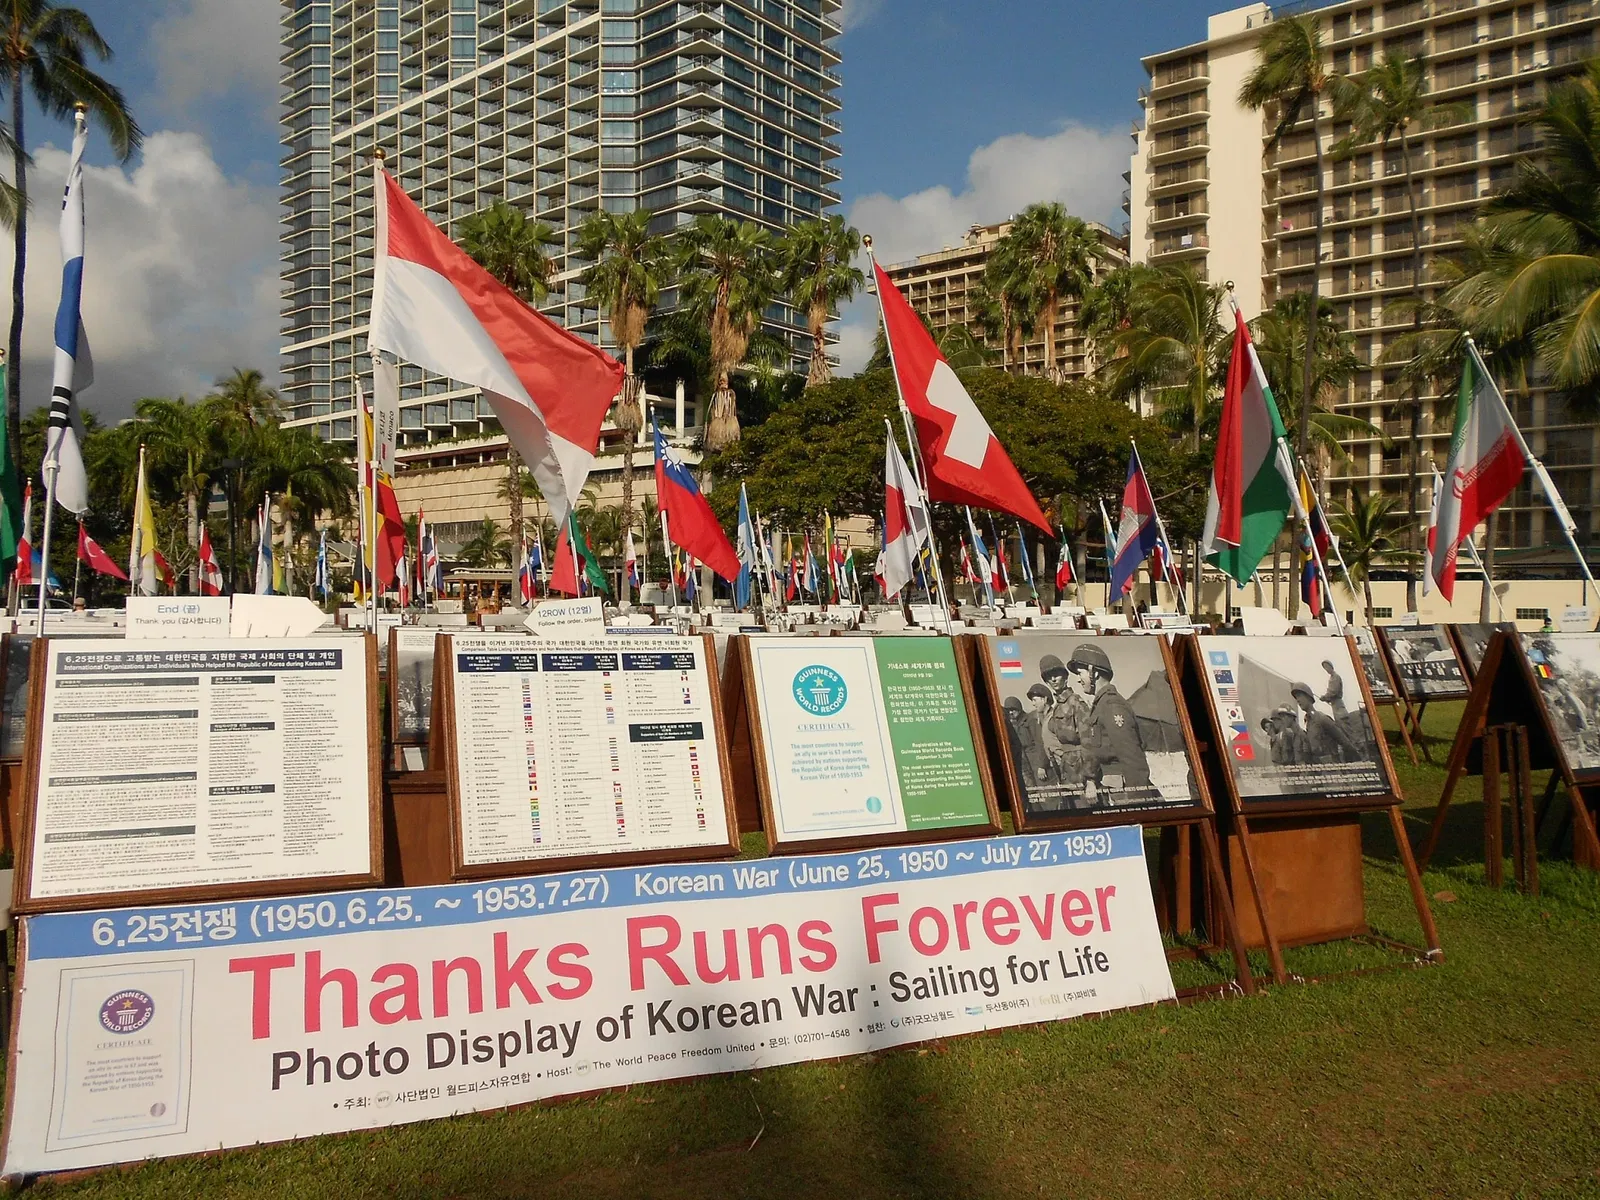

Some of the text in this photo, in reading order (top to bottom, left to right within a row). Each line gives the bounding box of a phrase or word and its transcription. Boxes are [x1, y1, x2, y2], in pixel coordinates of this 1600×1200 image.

[158, 604, 200, 614] End (끝)
[538, 605, 592, 618] 12ROW (12열)
[178, 617, 222, 626] (감사합니다)
[165, 653, 207, 662] 대한민국을
[212, 652, 236, 661] 지원한
[240, 652, 256, 660] 국제
[260, 652, 284, 660] 사회의
[288, 652, 304, 660] 단체
[308, 652, 316, 660] 및
[319, 652, 335, 660] 개인
[798, 668, 839, 683] GUINNESS
[796, 686, 845, 713] WORLD RECORDS
[797, 722, 852, 730] CERTIFICATE
[92, 906, 236, 947] 6.25전쟁
[250, 896, 422, 937] (1950.6.25.
[472, 874, 609, 913] 1953.7.27)
[634, 872, 725, 896] Korean
[734, 867, 780, 890] War
[788, 860, 849, 888] (June
[858, 857, 890, 881] 25,
[901, 849, 948, 872] 1950
[981, 844, 1022, 868] July
[1030, 840, 1058, 863] 27,
[1064, 834, 1113, 858] 1953)
[229, 885, 1116, 1040] Thanks Runs Forever
[107, 991, 149, 1007] GUINNESS
[102, 1006, 152, 1032] WORLD RECORDS
[272, 945, 1110, 1090] Photo Display of Korean War : Sailing for Life
[96, 1038, 154, 1049] CERTIFICATE
[344, 1096, 371, 1110] 주최:
[395, 1086, 440, 1104] 사단법인
[446, 1072, 531, 1096] 월드피스자유연합
[546, 1066, 573, 1078] Host:
[593, 1060, 611, 1070] The
[616, 1055, 643, 1067] World
[648, 1052, 677, 1063] Peace
[681, 1046, 722, 1059] Freedom
[726, 1042, 756, 1054] United
[768, 1036, 790, 1048] 문의:
[794, 1028, 851, 1046] (02)701-4548
[866, 1022, 886, 1034] 협찬:
[902, 1010, 955, 1026] (주)굿모닝월드
[986, 998, 1030, 1014] 두산동아(주)
[1064, 988, 1098, 1002] (주)파비엘
